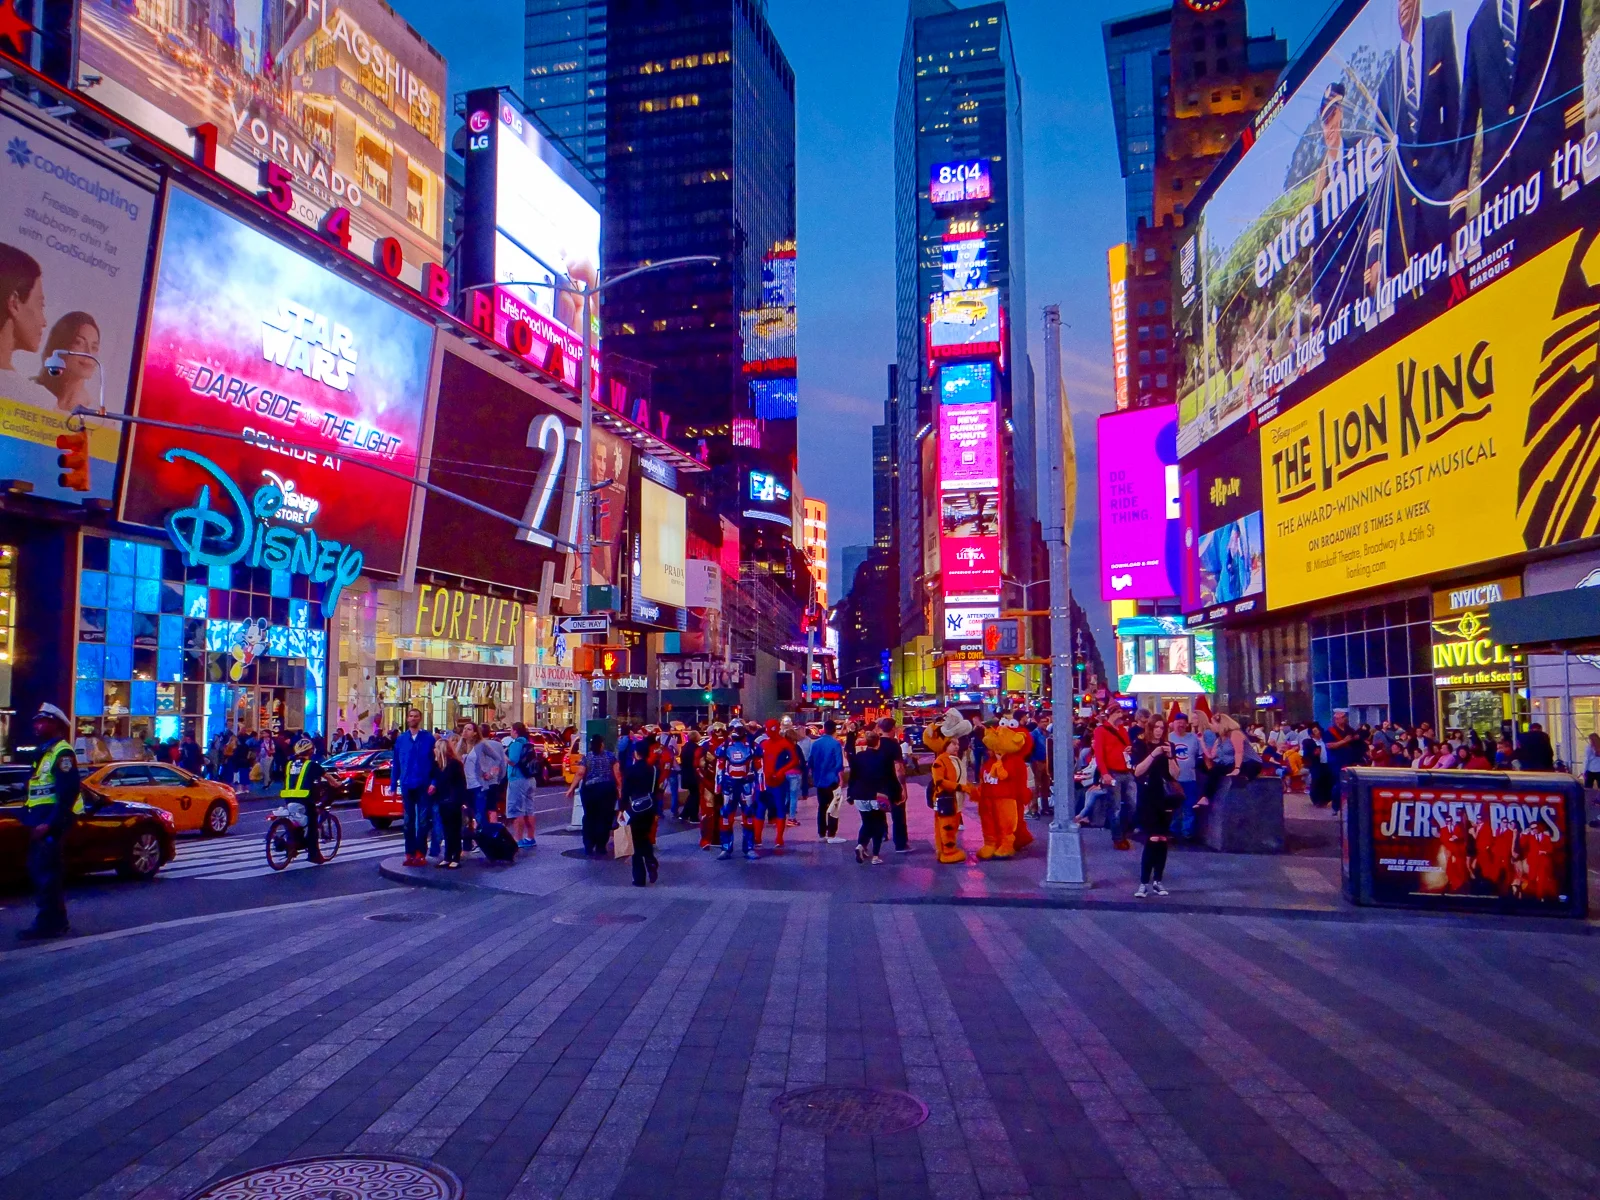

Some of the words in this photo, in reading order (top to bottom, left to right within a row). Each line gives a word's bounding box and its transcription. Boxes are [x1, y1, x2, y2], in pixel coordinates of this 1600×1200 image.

[511, 113, 523, 134] LG
[228, 97, 362, 207] VORNADO
[470, 135, 488, 150] LG
[939, 162, 982, 184] 8:04
[34, 155, 139, 221] coolsculpting
[42, 191, 79, 219] Freeze
[81, 214, 109, 234] away
[1254, 203, 1315, 288] extra
[1322, 136, 1383, 230] mile
[24, 207, 77, 238] stubborn
[80, 232, 101, 249] chin
[105, 240, 118, 256] fat
[949, 220, 979, 234] 2016
[943, 242, 985, 252] WELCOME
[1469, 239, 1515, 277] MARRIOTT
[942, 261, 960, 270] NEW
[964, 260, 987, 269] YORK
[1263, 356, 1292, 392] From
[1296, 328, 1325, 368] take
[1328, 303, 1351, 345] off
[1354, 296, 1371, 328] to
[1376, 243, 1447, 313] landing,
[1455, 171, 1541, 265] putting
[1551, 131, 1599, 189] the
[1470, 257, 1510, 290] MARQUIS
[277, 300, 358, 363] STAR
[262, 321, 357, 392] WARS
[932, 343, 999, 357] TOSHIBA
[191, 366, 257, 410] DARK
[256, 390, 301, 425] SIDE
[321, 412, 355, 443] THE
[354, 424, 402, 460] LIGHT
[1271, 435, 1312, 494] THE
[1319, 393, 1389, 491] LION
[1397, 340, 1495, 458] KING
[1109, 470, 1126, 483] DO
[1277, 520, 1295, 538] THE
[1296, 479, 1393, 531] AWARD-WINNING
[1395, 465, 1425, 494] BEST
[1427, 437, 1497, 482] MUSICAL
[1111, 482, 1134, 497] THE
[1111, 496, 1139, 510] RIDE
[275, 508, 305, 524] STORE
[1308, 539, 1320, 552] ON
[1321, 522, 1362, 550] BROADWAY
[1363, 522, 1369, 535] 8
[1370, 512, 1394, 532] TIMES
[1396, 508, 1404, 523] A
[1405, 500, 1431, 521] WEEK
[1363, 537, 1398, 557] Broadway
[1400, 532, 1406, 546] &
[1407, 525, 1425, 544] 45th
[1427, 523, 1436, 538] St
[664, 563, 684, 579] PRADA
[1111, 561, 1142, 570] DOWNLOAD
[1346, 560, 1387, 581] lionking.com
[1111, 573, 1132, 591] lyft
[1449, 583, 1502, 610] INVICTA
[415, 584, 522, 646] FOREVER
[573, 621, 586, 629] ONE
[588, 620, 602, 628] WAY
[947, 613, 964, 632] NY
[1475, 671, 1490, 683] the
[1381, 801, 1482, 838] JERSEY
[1490, 801, 1561, 843] BOYS
